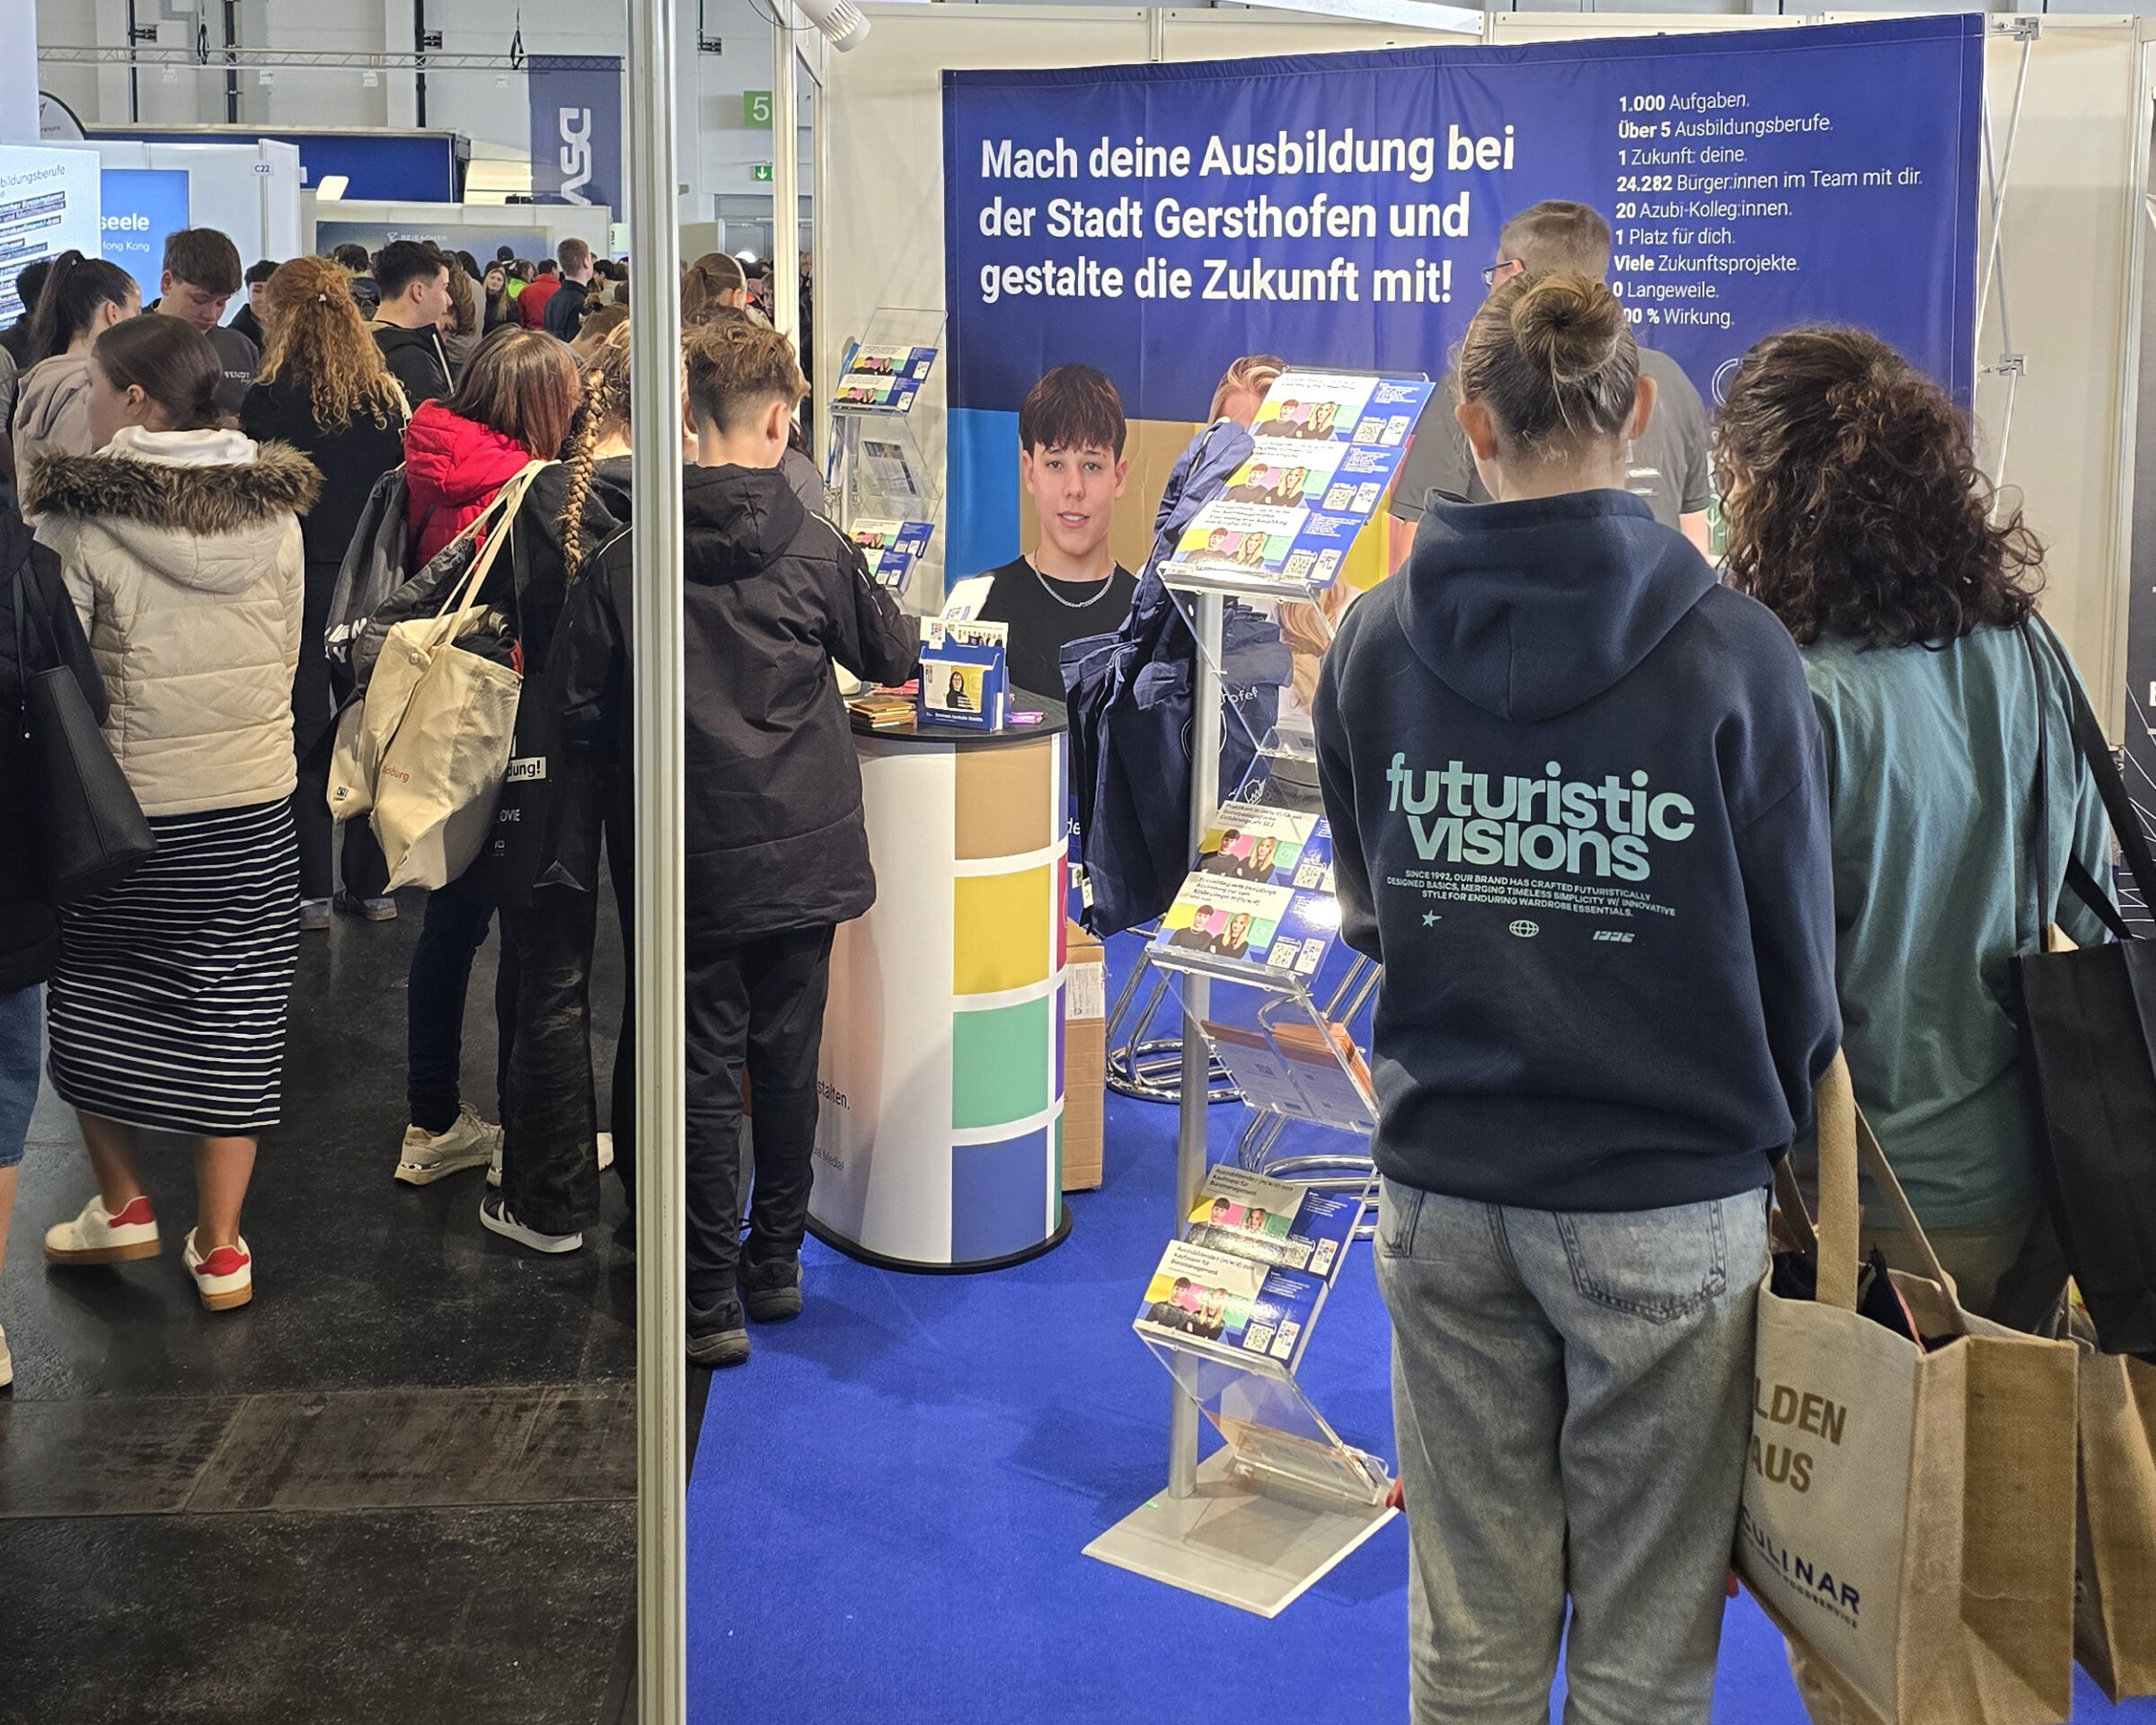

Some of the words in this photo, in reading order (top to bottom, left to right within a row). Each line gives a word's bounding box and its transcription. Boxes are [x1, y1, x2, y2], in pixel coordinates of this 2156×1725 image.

[753, 96, 770, 121] 5
[1619, 95, 1665, 112] 1.000
[1669, 92, 1750, 113] Aufgaben.
[1618, 121, 1657, 139] Über
[1660, 122, 1671, 137] 5
[1675, 113, 1834, 137] Ausbildungsberufe.
[981, 138, 1078, 179] Mach
[1089, 136, 1191, 179] deine
[1199, 128, 1435, 182] Ausbildung
[1448, 124, 1515, 171] bei
[1618, 150, 1627, 165] 1
[1701, 147, 1748, 164] deine.
[254, 164, 270, 173] C22
[1617, 175, 1673, 192] 24.282
[1677, 172, 1778, 194] Bürger:innen
[1783, 172, 1806, 189] im
[1810, 170, 1858, 187] Team
[1863, 169, 1892, 186] mit
[1898, 166, 1923, 185] dir.
[101, 213, 150, 231] seele
[979, 197, 1035, 237] der
[1047, 197, 1144, 238] Stadt
[1154, 193, 1376, 238] Gersthofen
[1389, 191, 1470, 237] und
[1615, 202, 1636, 219] 20
[1639, 199, 1793, 221] Azubi-Kolleg:innen.
[126, 241, 150, 252] Kong
[1615, 229, 1623, 245] 1
[1630, 228, 1668, 244] Platz
[1673, 227, 1694, 244] für
[1698, 226, 1736, 244] dich.
[1614, 255, 1655, 271] Viele
[1658, 254, 1800, 274] Zukunftsprojekte.
[980, 256, 1123, 304] gestalte
[1134, 258, 1192, 300] die
[1203, 257, 1359, 301] Zukunft
[1373, 259, 1453, 303] mit!
[1613, 281, 1623, 298] 0
[1627, 281, 1719, 301] Langeweile.
[1623, 307, 1642, 324] 00
[1647, 307, 1660, 324] %
[1664, 307, 1735, 328] Wirkung.
[1386, 752, 1695, 841] futuristic
[1407, 815, 1651, 881] visions
[1387, 876, 1425, 888] DESIGNED
[1427, 881, 1460, 891] BASICS,
[1461, 883, 1506, 895] MERGING
[1507, 887, 1552, 898] TIMELESS
[1553, 892, 1604, 905] SIMPLICITY
[1621, 899, 1676, 916] INNOVATIVE
[1405, 870, 1430, 880] SINCE
[1431, 871, 1453, 881] 1992,
[1454, 873, 1473, 882] OUR
[1474, 874, 1507, 886] BRAND
[1509, 877, 1529, 887] HAS
[1531, 880, 1573, 892] CRAFTED
[1574, 885, 1651, 901] FUTURISTICALLY
[1422, 889, 1447, 899] STYLE
[1448, 891, 1467, 901] FOR
[1468, 894, 1518, 906] ENDURING
[1518, 898, 1572, 911] WARDROBE
[1573, 904, 1634, 917] ESSENTIALS.
[1754, 1376, 1847, 1446] LDEN
[1739, 1504, 1860, 1615] CULINAR
